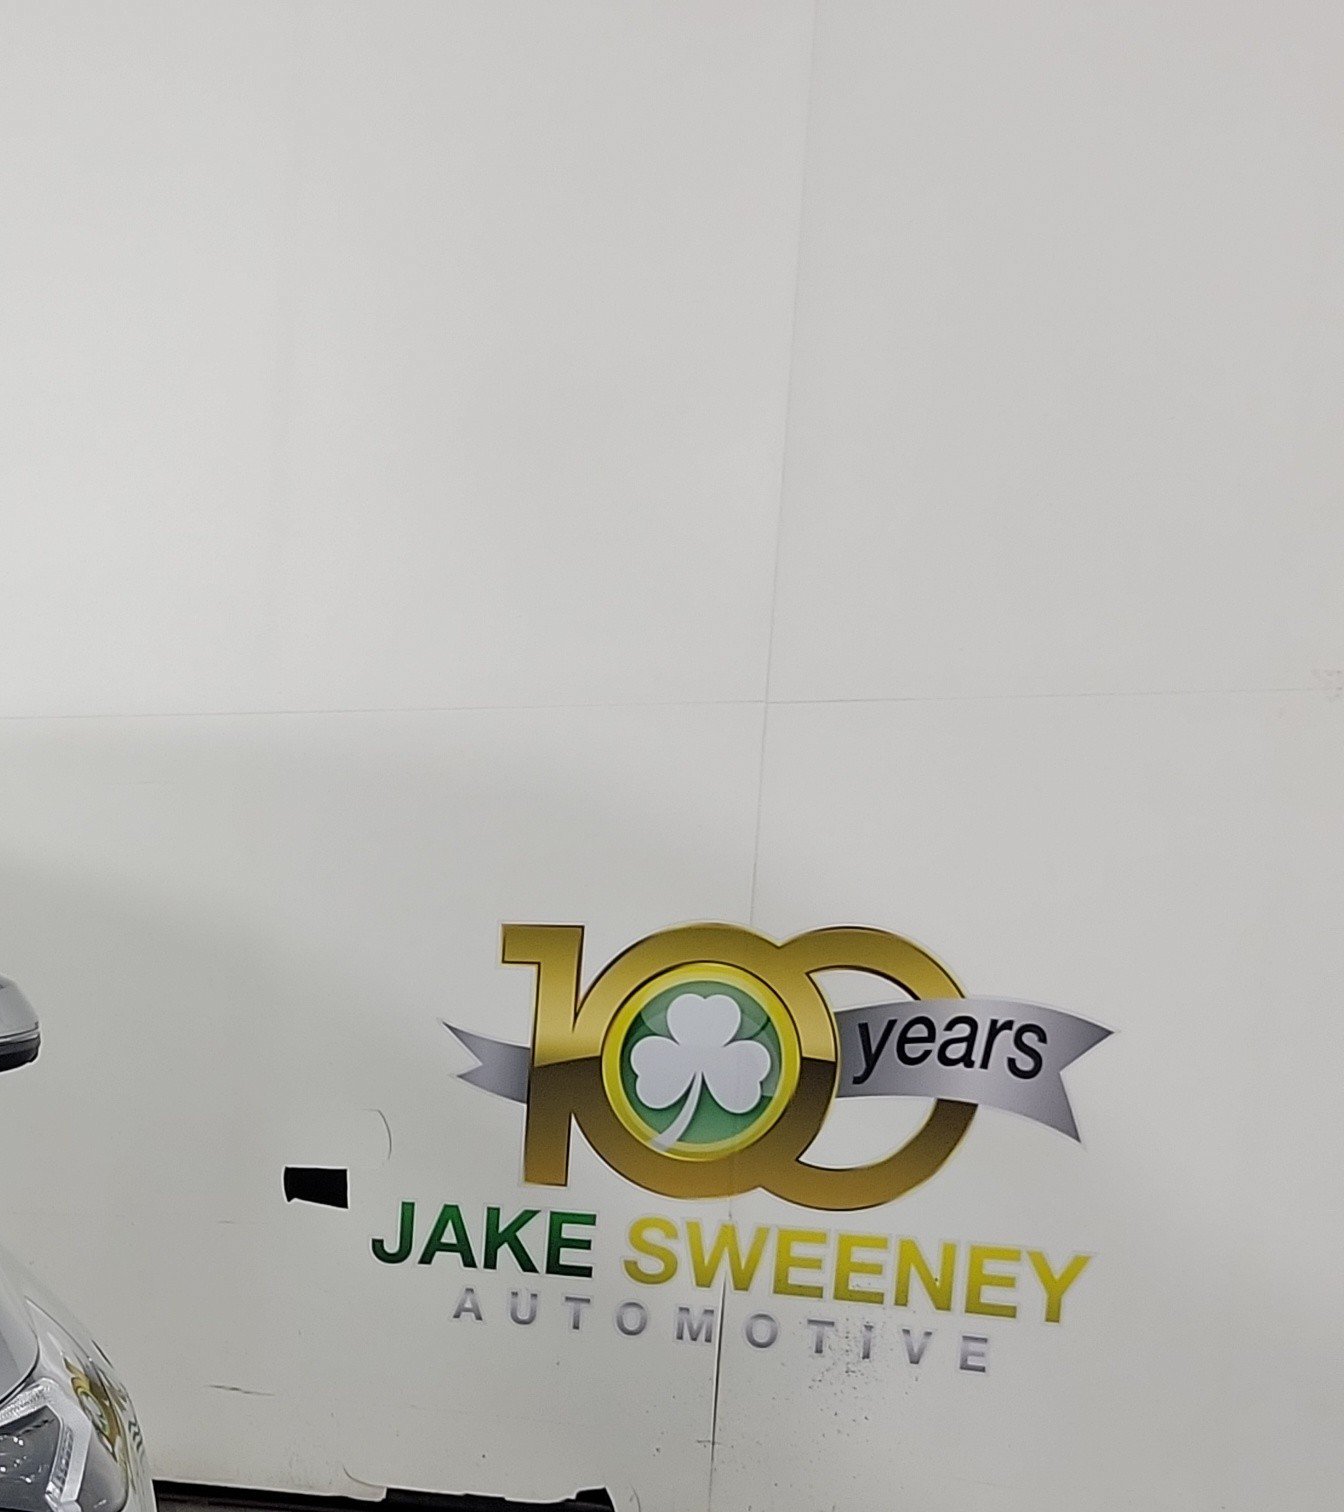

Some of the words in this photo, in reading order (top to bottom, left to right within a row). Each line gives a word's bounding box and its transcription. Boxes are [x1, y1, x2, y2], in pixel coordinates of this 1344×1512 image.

[852, 1013, 1048, 1085] years
[371, 1201, 597, 1278] JAKE
[623, 1216, 1090, 1323] SWEENEY
[452, 1287, 990, 1373] AUTOMOTIVE
